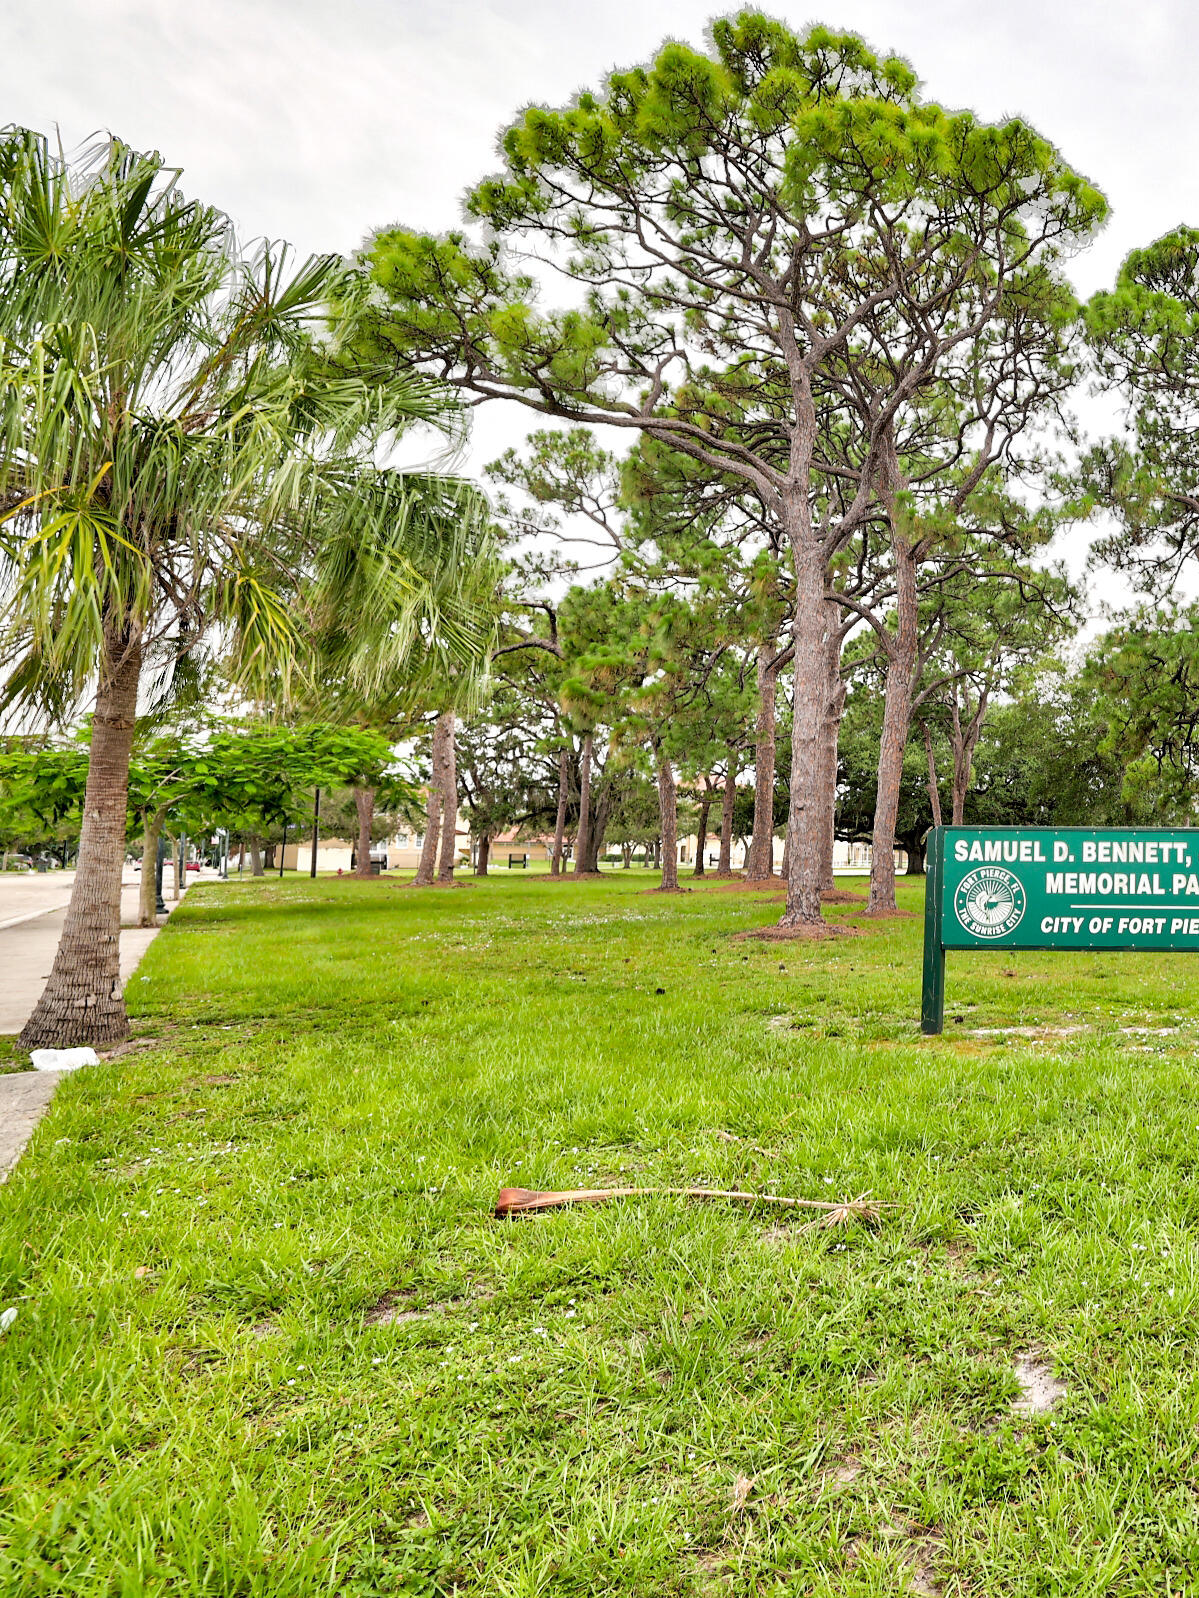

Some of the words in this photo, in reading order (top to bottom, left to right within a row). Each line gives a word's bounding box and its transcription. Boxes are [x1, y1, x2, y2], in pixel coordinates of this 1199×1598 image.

[955, 840, 1046, 863] SAMUEL
[1053, 841, 1074, 863] D.
[1082, 841, 1192, 868] BENNETT,
[960, 873, 978, 893] FORT
[1011, 882, 1020, 894] FL
[1046, 873, 1166, 895] MEMORIAL
[959, 907, 972, 925] THE
[970, 921, 1007, 935] SUNRISE
[1005, 908, 1022, 928] CITY
[1040, 916, 1085, 934] CITY
[1088, 917, 1113, 934] OF
[1117, 917, 1167, 935] FORT
